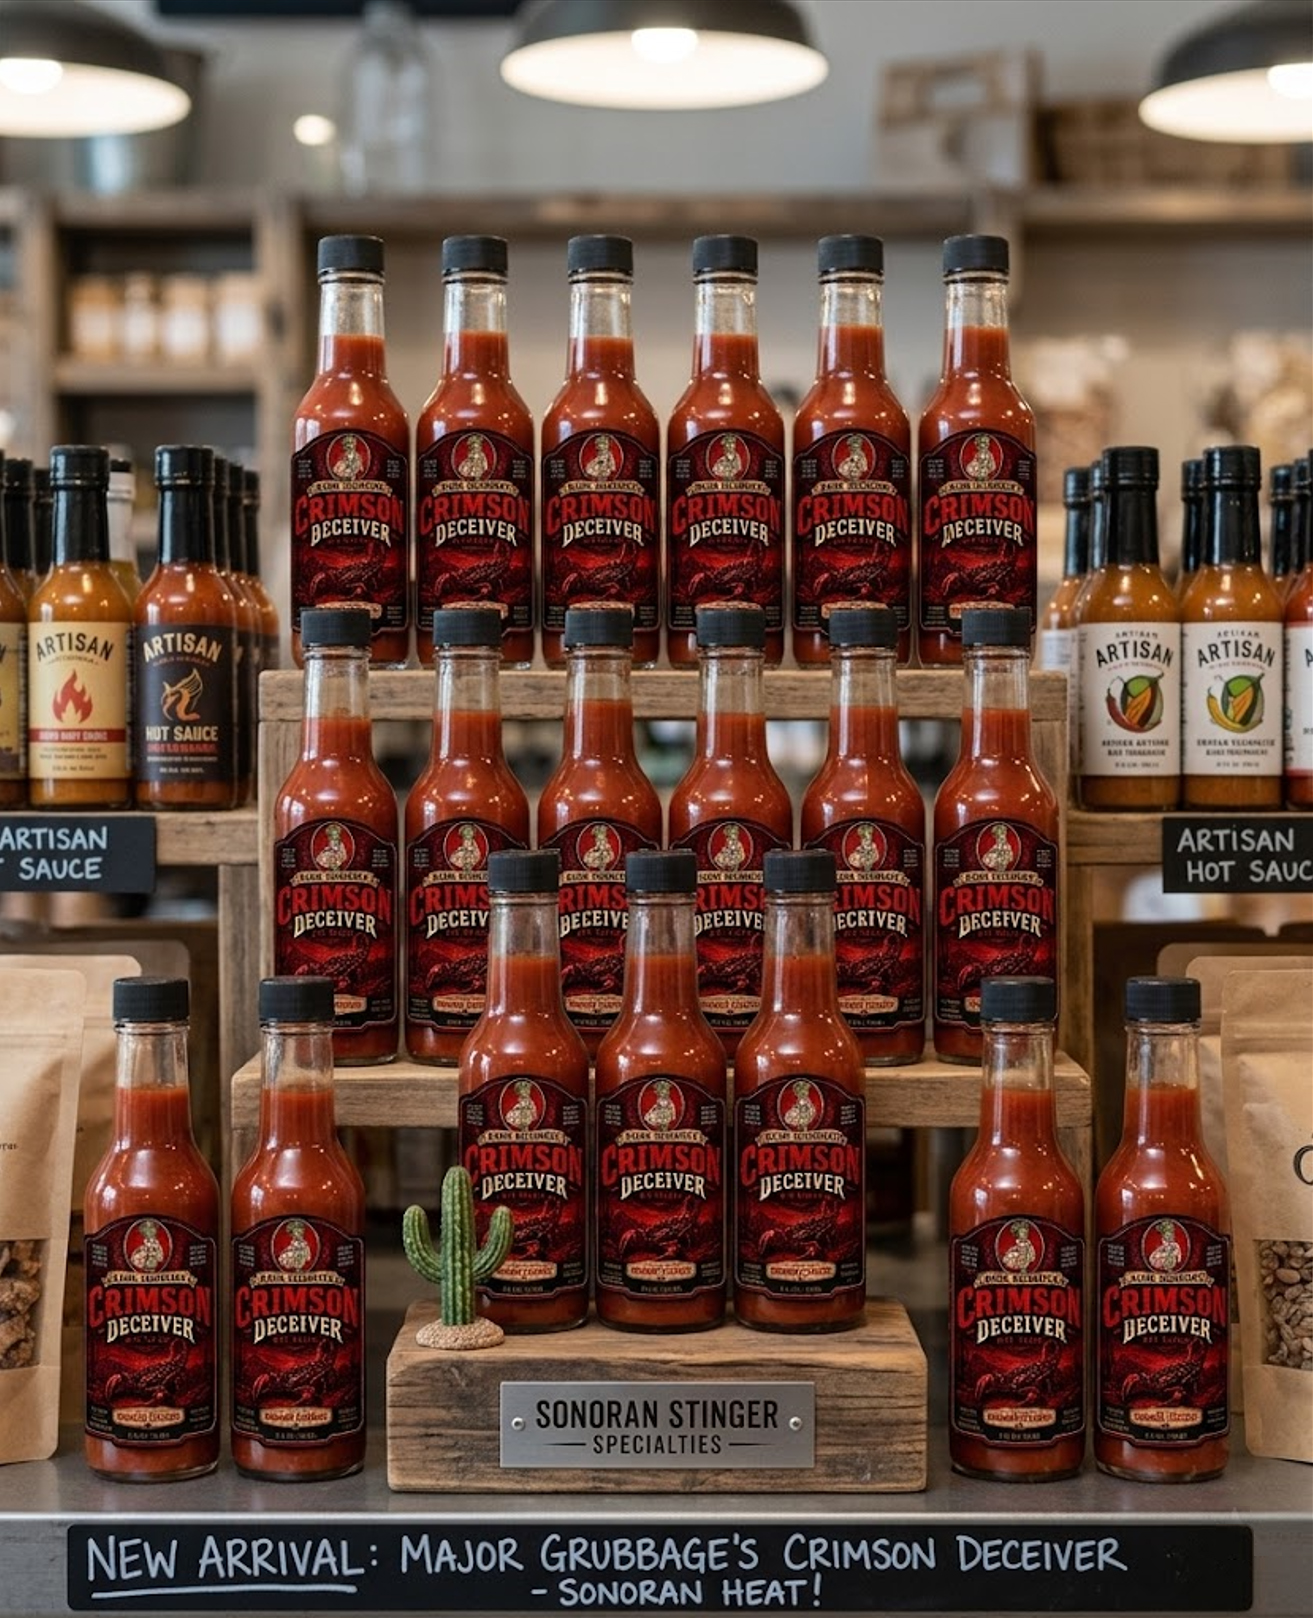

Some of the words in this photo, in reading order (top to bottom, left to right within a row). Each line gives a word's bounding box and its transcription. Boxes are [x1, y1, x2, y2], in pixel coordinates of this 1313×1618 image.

[295, 494, 404, 536] CRIMSON
[420, 494, 530, 536] CRIMSON
[546, 494, 655, 536] CRIMSON
[672, 494, 781, 536] CRIMSON
[797, 494, 908, 536] CRIMSON
[924, 494, 1034, 537] CRIMSON
[435, 518, 517, 547] DECEIVER
[562, 518, 644, 548] DECEIVER
[689, 518, 769, 547] DECEIVER
[815, 518, 896, 547] DECEIVER
[36, 632, 115, 662] ARTISAN
[144, 633, 222, 662] ARTISAN
[1096, 639, 1174, 668] ARTISAN
[1198, 639, 1275, 668] ARTISAN
[174, 726, 218, 741] SAUCE
[0, 826, 108, 850] ARTISAN
[18, 857, 103, 880] SAUCE
[1187, 860, 1236, 882] HOT
[1249, 859, 1313, 882] SAUC
[278, 884, 391, 926] CRIMSON
[410, 884, 490, 926] CRIMS
[559, 884, 629, 913] RIMS
[834, 884, 920, 925] IMSON
[939, 884, 1053, 926] CRIMSON
[293, 910, 377, 939] DECEIVER
[426, 910, 489, 939] DECEIV
[601, 1144, 720, 1186] CRIMSON
[740, 1144, 860, 1186] CRIMSON
[481, 1172, 568, 1200] DECEIVER
[620, 1172, 706, 1200] DECEIVER
[759, 1172, 845, 1200] DECEIVER
[88, 1286, 212, 1328] CRIMSON
[235, 1286, 358, 1328] CRIMSON
[957, 1286, 1081, 1328] CRIMSON
[1103, 1286, 1226, 1328] CRIMSON
[106, 1315, 196, 1344] DECEIVER
[253, 1315, 343, 1344] DECEIVER
[976, 1315, 1067, 1344] DECEIVER
[1122, 1315, 1213, 1344] DECEIVER
[535, 1399, 658, 1429] SONORAN
[669, 1399, 778, 1429] STINGER
[593, 1434, 722, 1455] SPECIALTIES
[87, 1535, 177, 1581] NEW
[199, 1535, 378, 1579] ARRIVAL:
[400, 1534, 524, 1574] MAJOR
[540, 1533, 758, 1575] GRUBBAGE'S
[784, 1533, 935, 1571] CRIMSON
[956, 1535, 1127, 1571] DECEIVER
[559, 1578, 702, 1607] SONORAN
[722, 1572, 821, 1607] HEAT!
